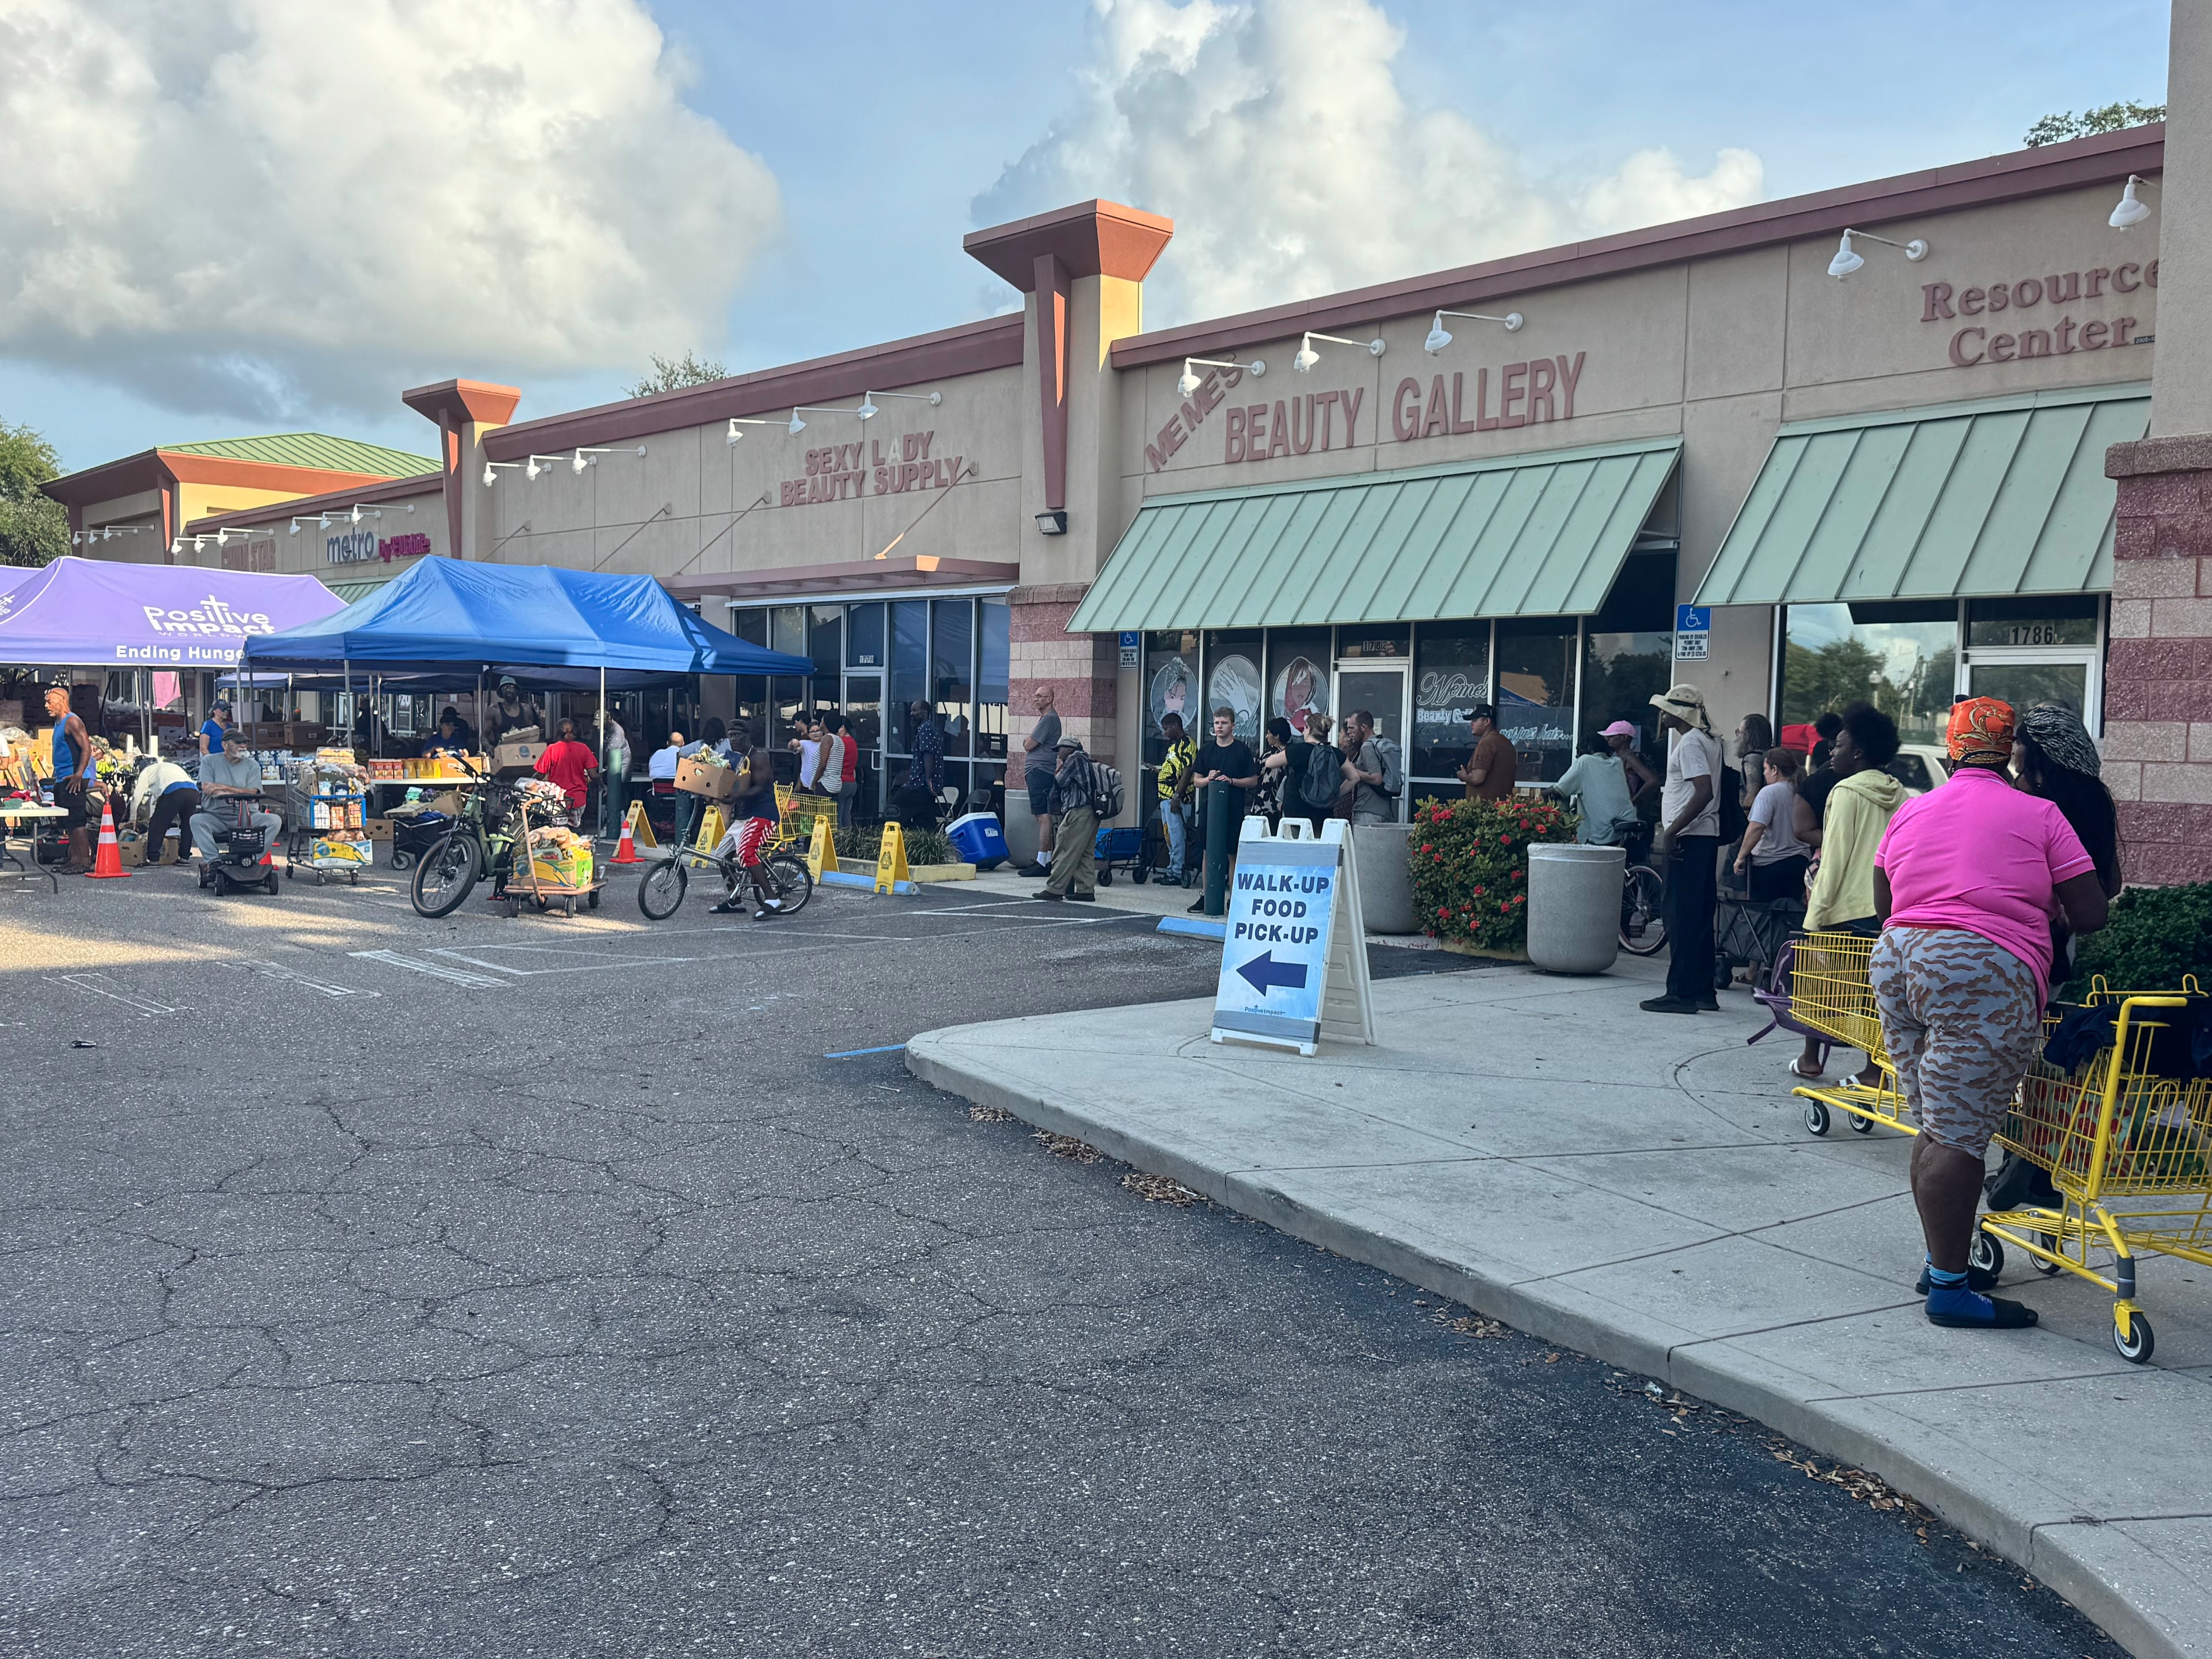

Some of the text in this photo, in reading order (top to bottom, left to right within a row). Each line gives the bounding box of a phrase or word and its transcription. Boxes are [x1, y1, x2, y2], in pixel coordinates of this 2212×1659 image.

[1948, 316, 2136, 366] Center
[1225, 351, 1586, 463] BEAUTY GALLERY
[806, 431, 934, 476] SEXY LADY
[781, 456, 963, 507] BEAUTY SUPPLY
[327, 527, 375, 563] metro
[143, 594, 270, 624] Positive
[150, 619, 276, 634] Impact
[2011, 626, 2054, 645] 1786
[116, 645, 244, 661] Ending Hunge
[1363, 641, 1387, 651] 1782
[1416, 708, 1452, 725] Beauty
[1237, 873, 1329, 893] WALK-UP
[1252, 899, 1306, 918] FOOD
[1234, 922, 1318, 944] PICK-UP
